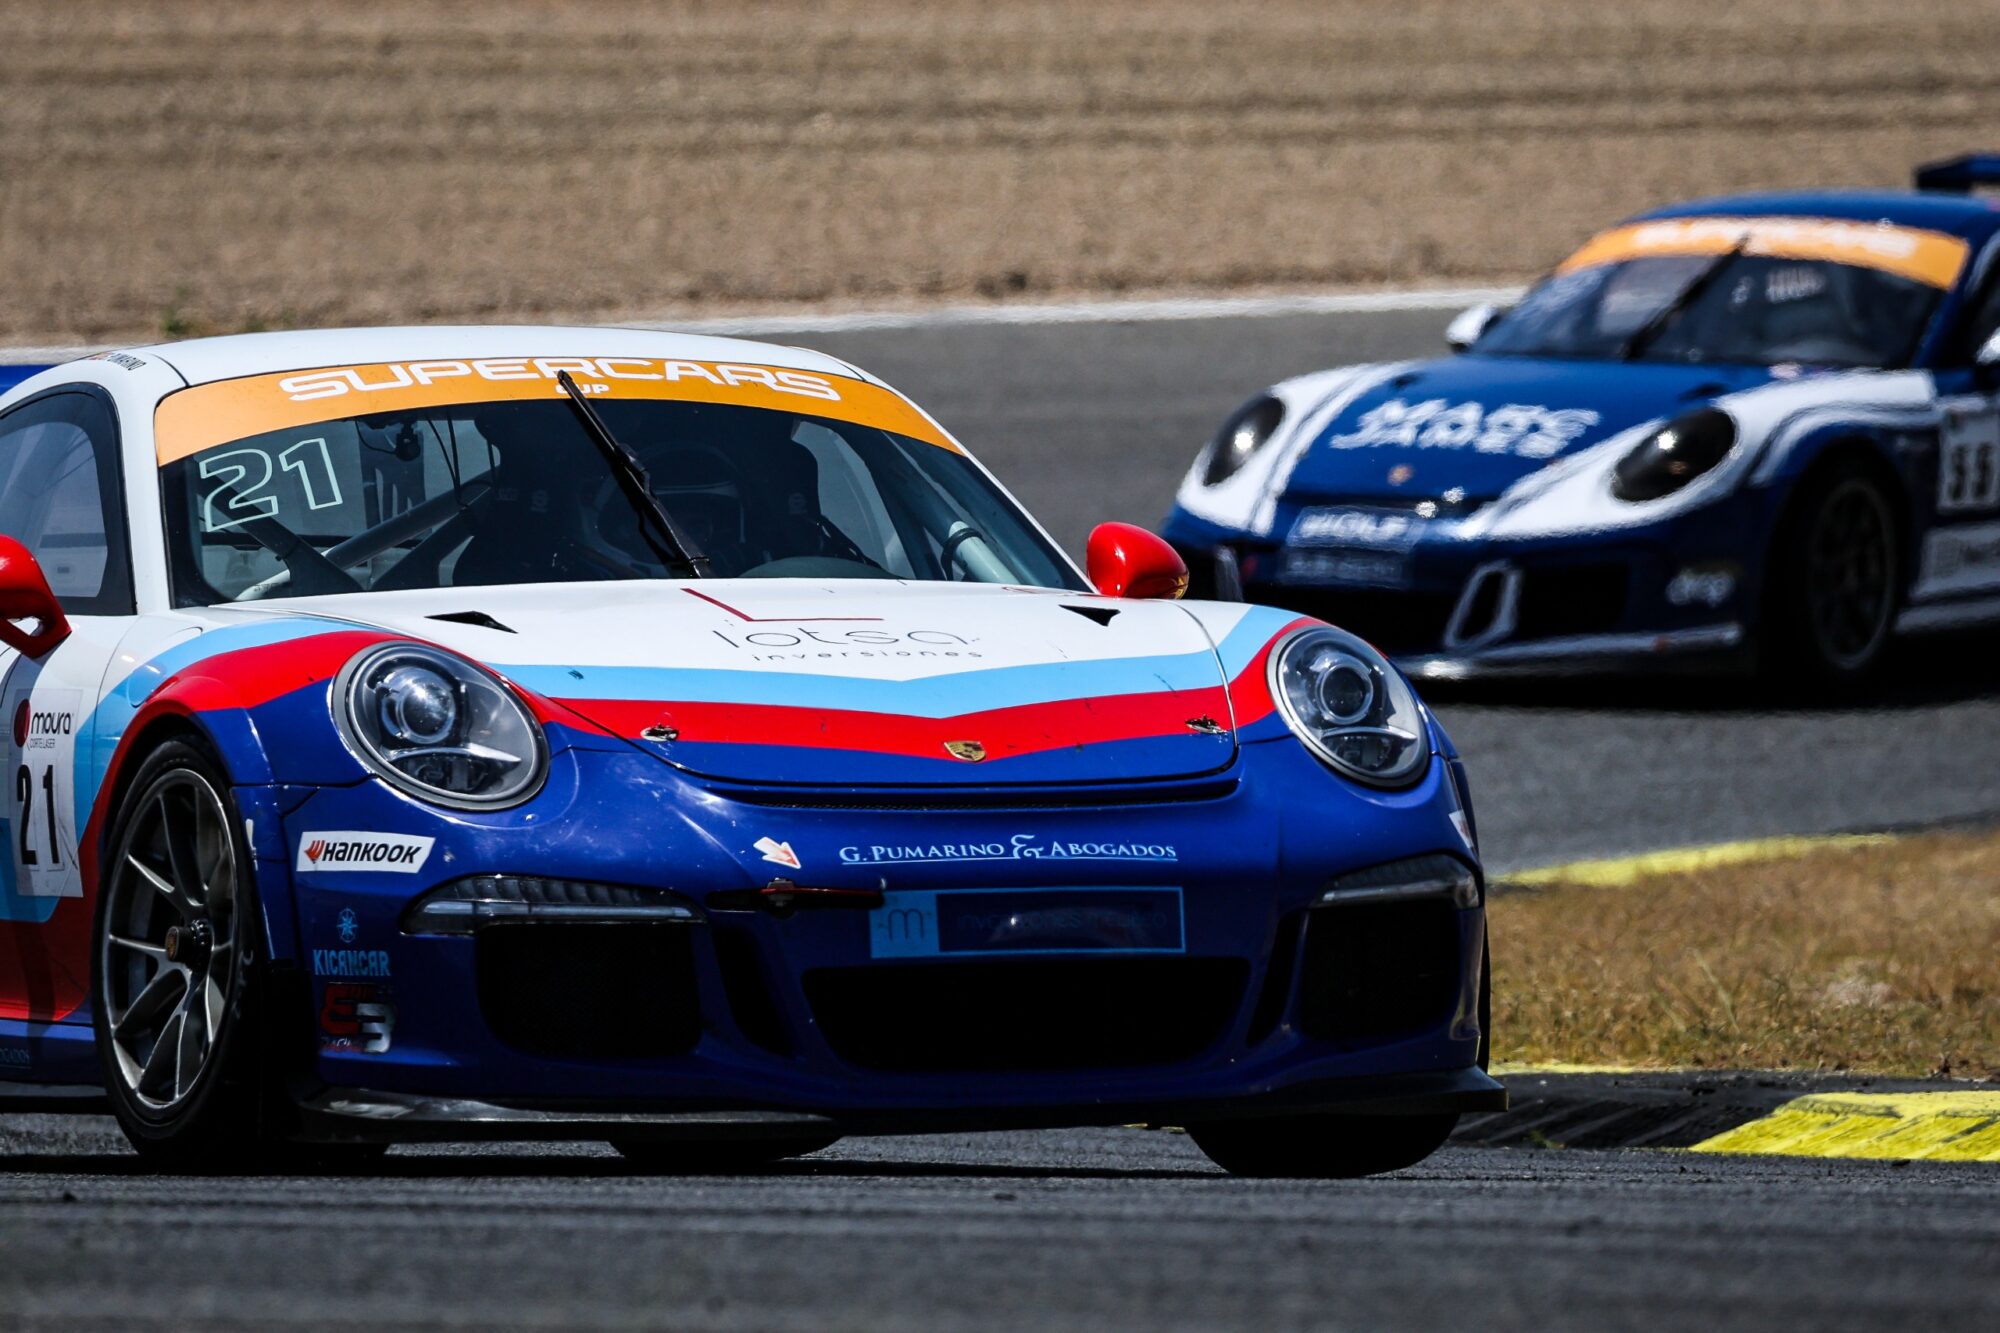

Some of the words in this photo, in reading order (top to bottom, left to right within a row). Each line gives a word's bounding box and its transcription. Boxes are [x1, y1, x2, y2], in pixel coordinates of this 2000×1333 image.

[279, 357, 841, 402] SUPERCARS
[200, 437, 343, 532] 21
[753, 650, 982, 662] inversiones
[30, 711, 72, 735] moura
[17, 764, 60, 865] 21
[313, 949, 391, 977] KICANCAR
